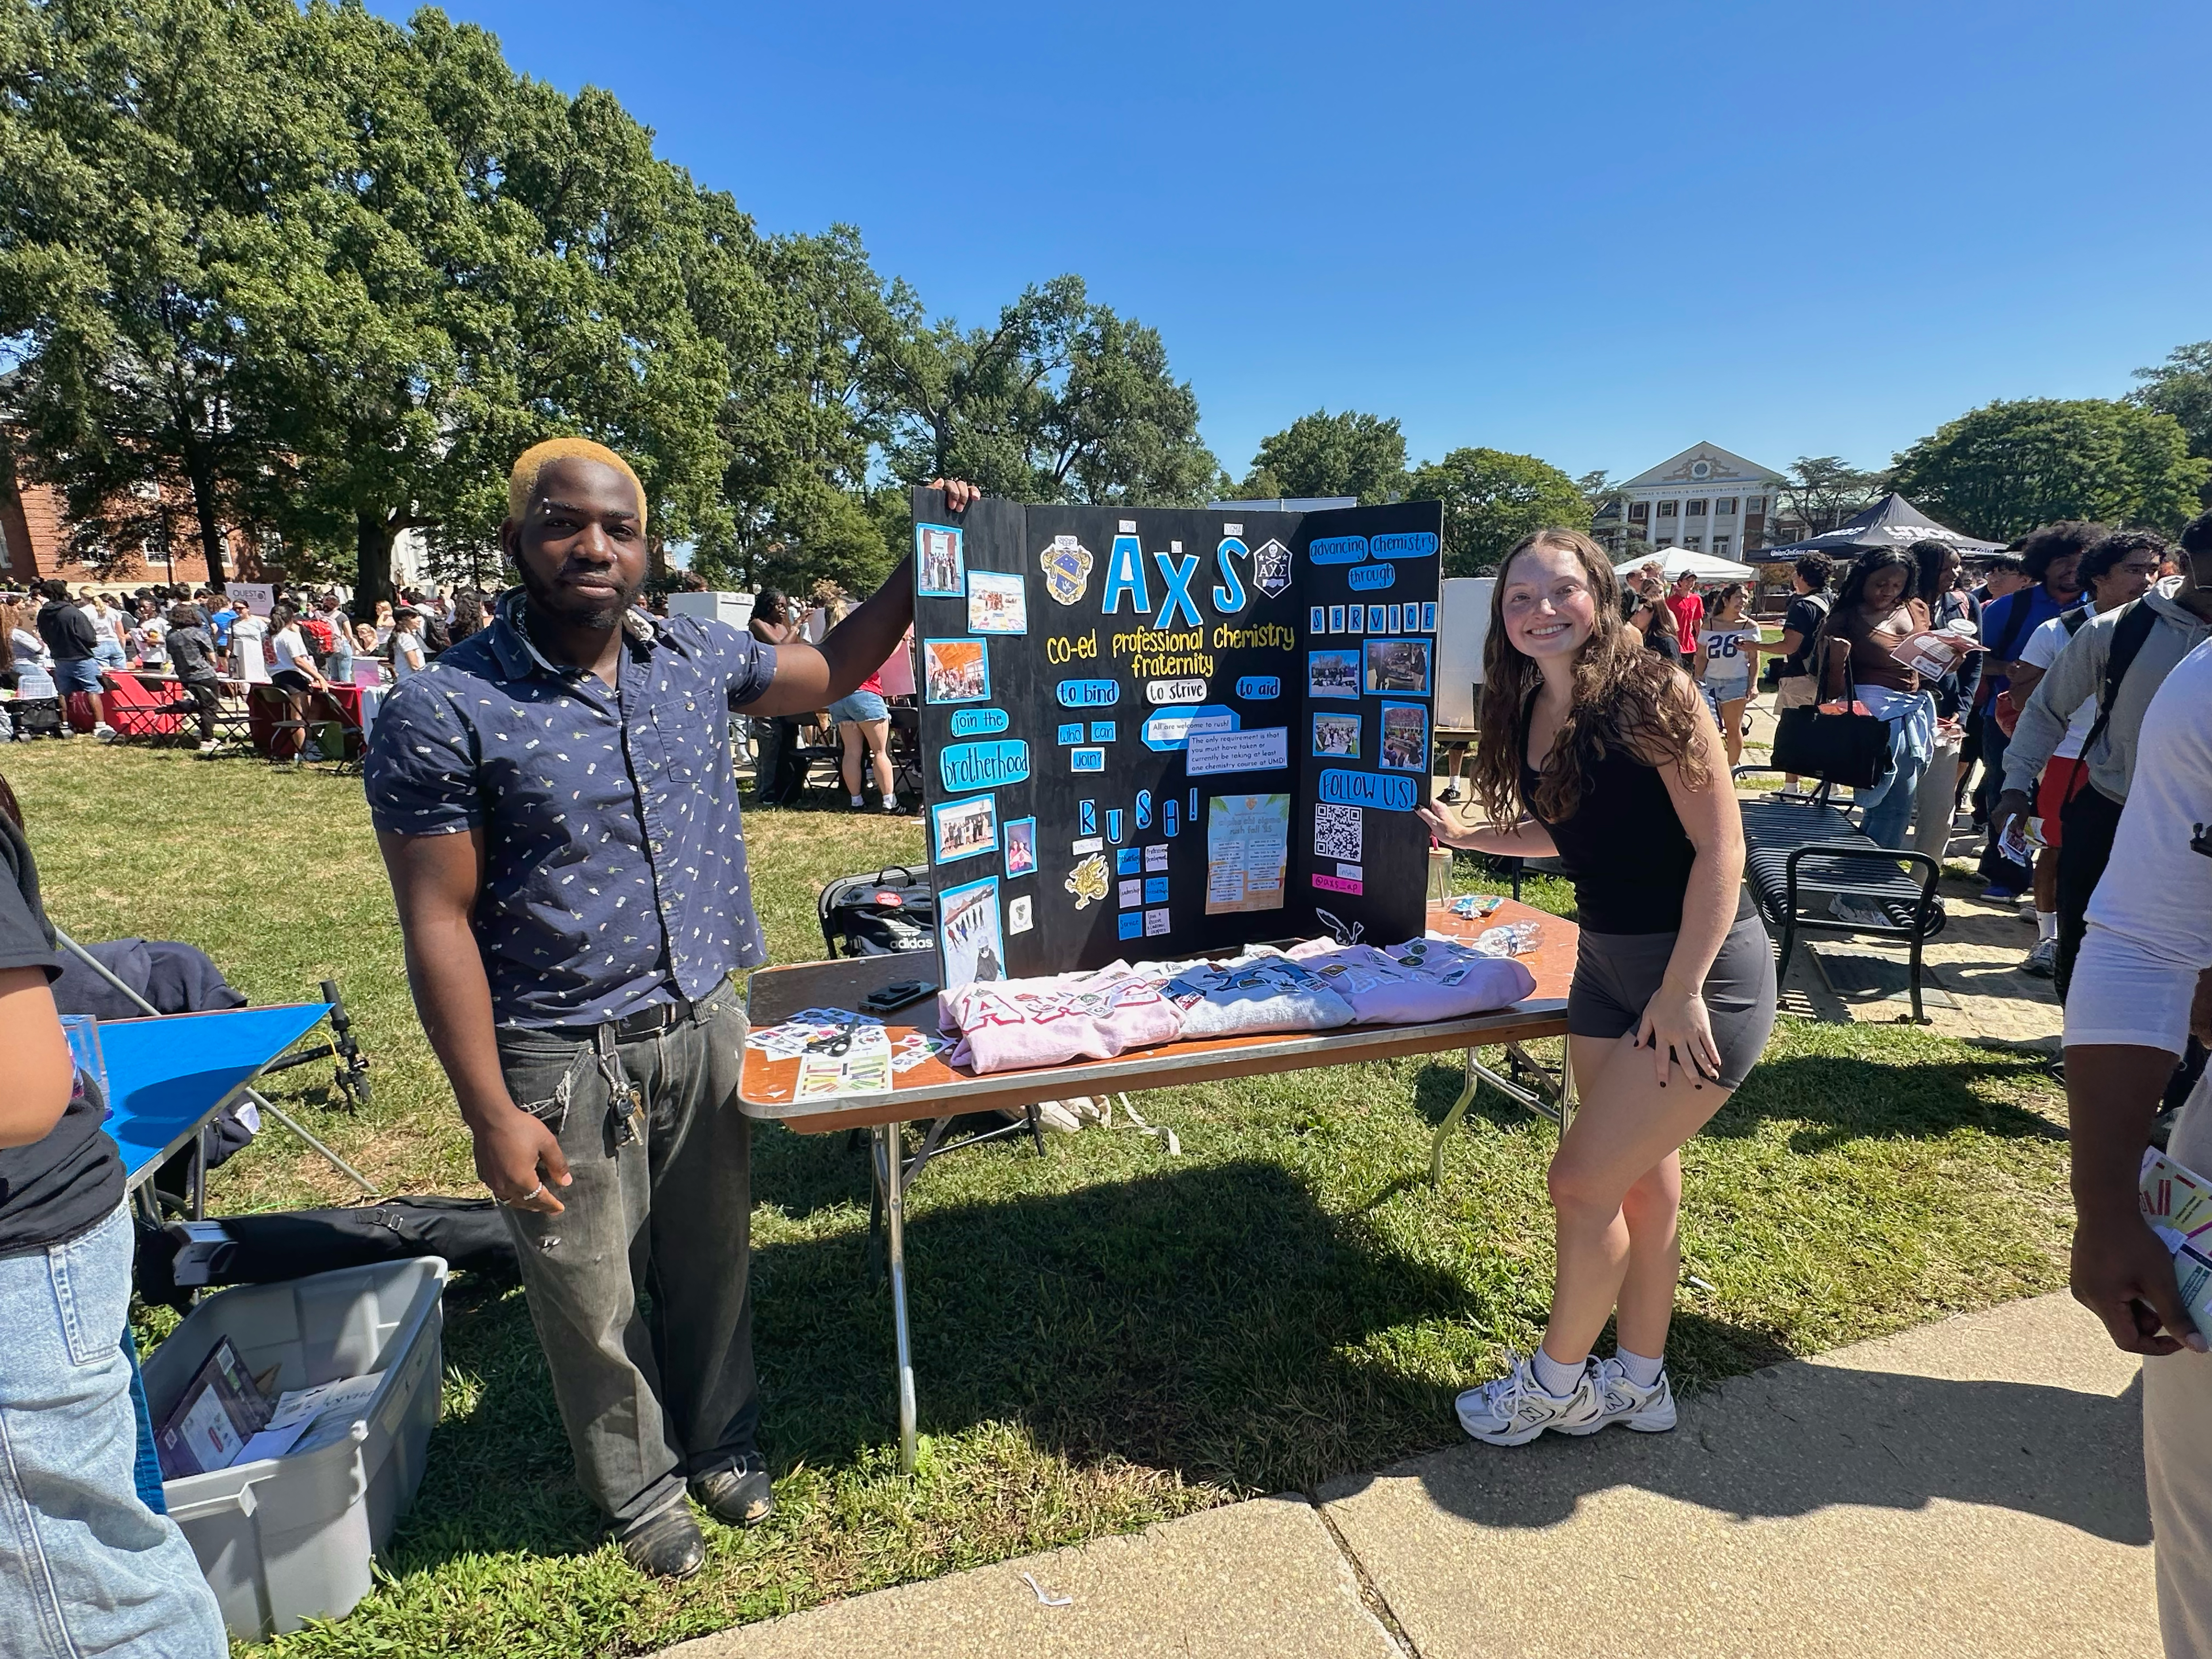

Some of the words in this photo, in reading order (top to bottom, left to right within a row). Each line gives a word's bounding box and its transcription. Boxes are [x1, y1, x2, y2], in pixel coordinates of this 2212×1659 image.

[1311, 538, 1364, 561] advancing
[1350, 565, 1393, 588] through
[1313, 607, 1432, 628] SERVICE
[1112, 625, 1203, 658] professional
[1131, 652, 1214, 678] fraternity
[1060, 683, 1076, 703] to
[1084, 681, 1115, 703] bind
[1150, 685, 1164, 700] to
[1169, 682, 1203, 699] strive
[1239, 680, 1252, 695] to
[1259, 679, 1278, 696] aid
[953, 713, 977, 736] join
[983, 711, 1003, 726] the
[1060, 726, 1081, 742] who
[1094, 726, 1114, 739] can
[1220, 734, 1258, 743] requirement
[943, 744, 1028, 786] brotherhood
[1192, 753, 1219, 762] currently
[1231, 751, 1252, 760] taking
[1205, 762, 1235, 770] chemistry
[1383, 778, 1414, 809] US!
[890, 937, 933, 949] adidas
